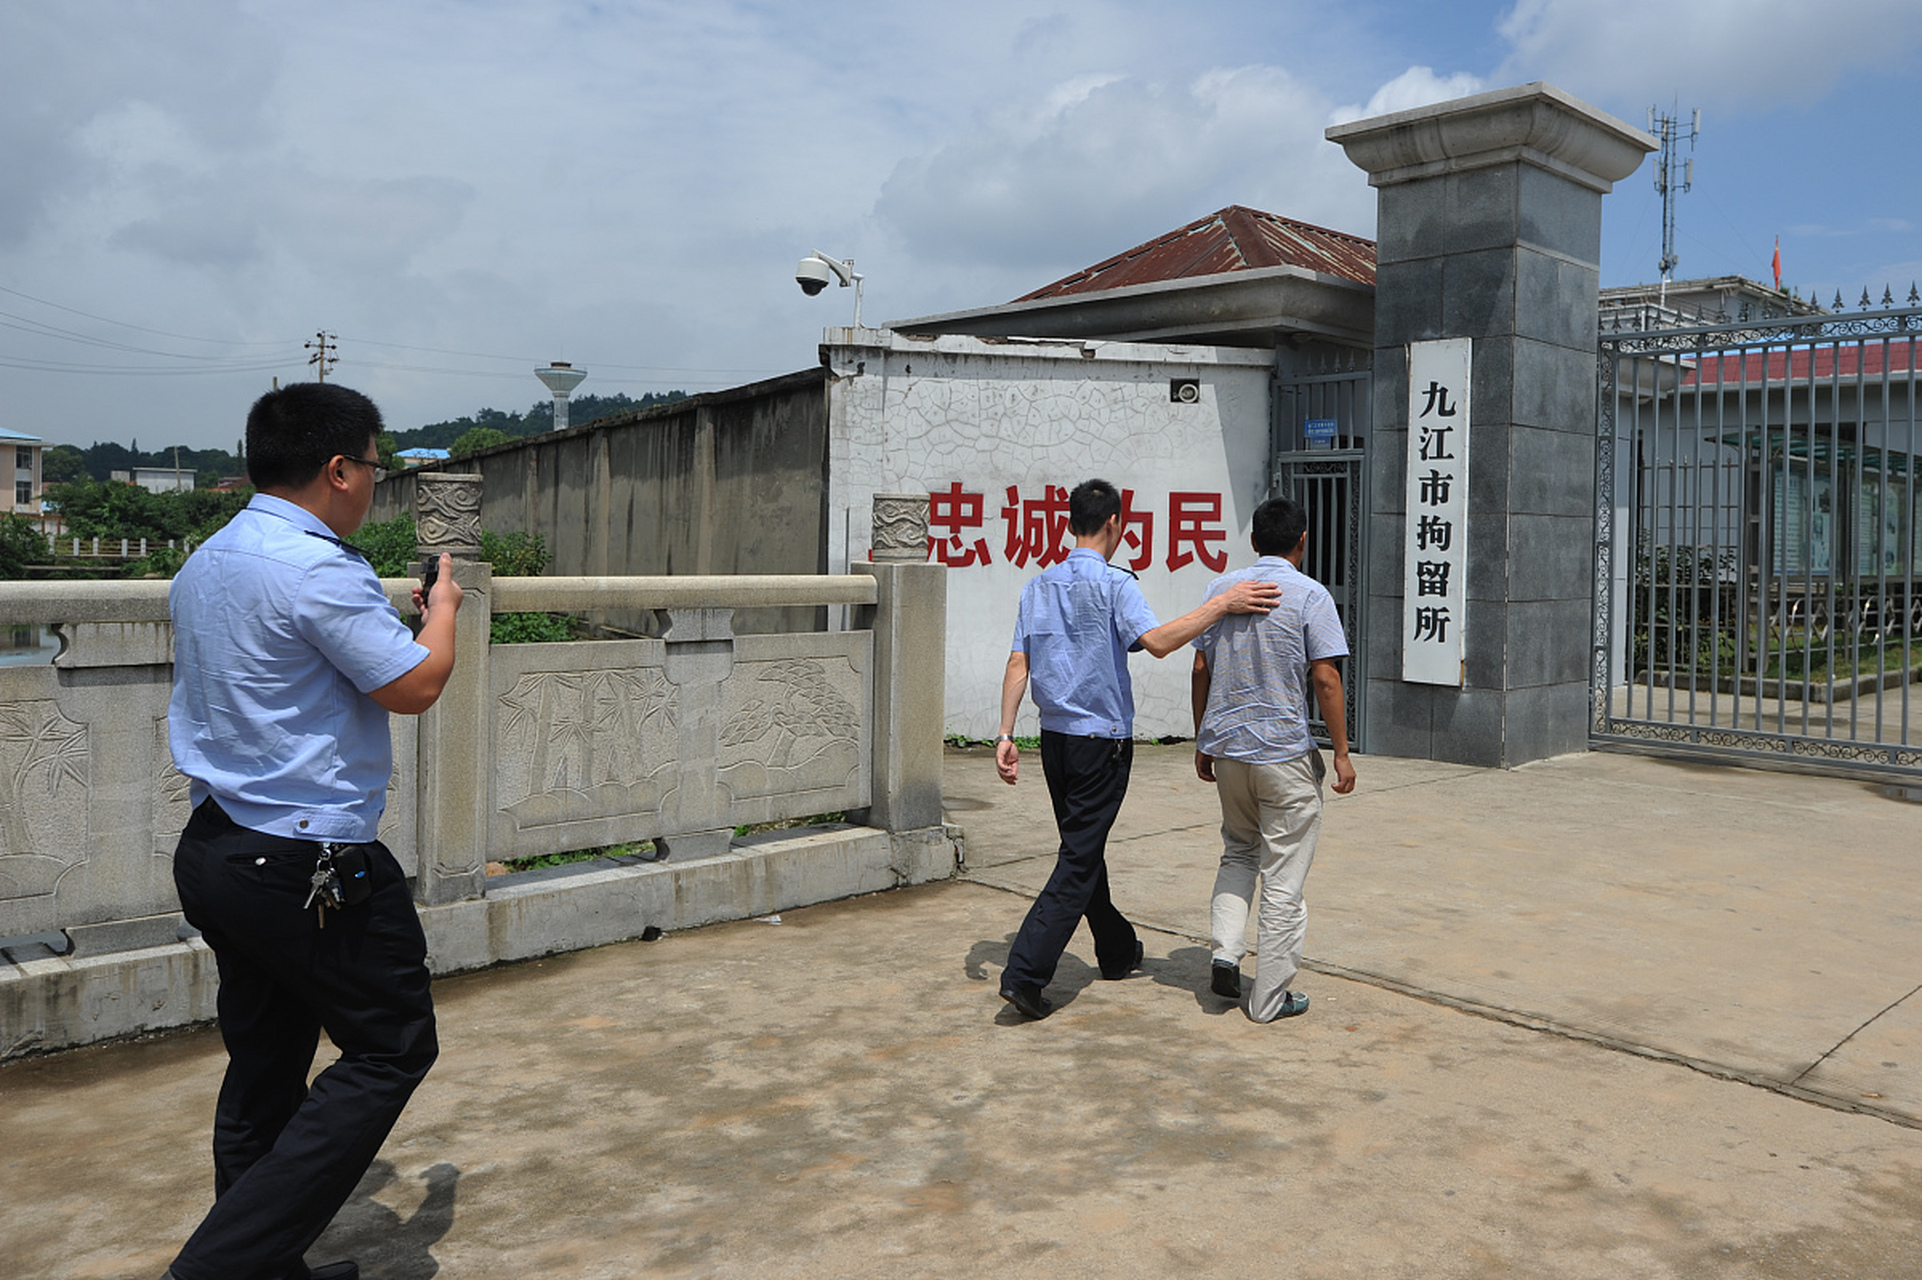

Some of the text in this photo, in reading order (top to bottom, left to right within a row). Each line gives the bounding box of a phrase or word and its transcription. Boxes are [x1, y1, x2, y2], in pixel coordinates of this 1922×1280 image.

[1413, 381, 1457, 643] 九江市拘留所
